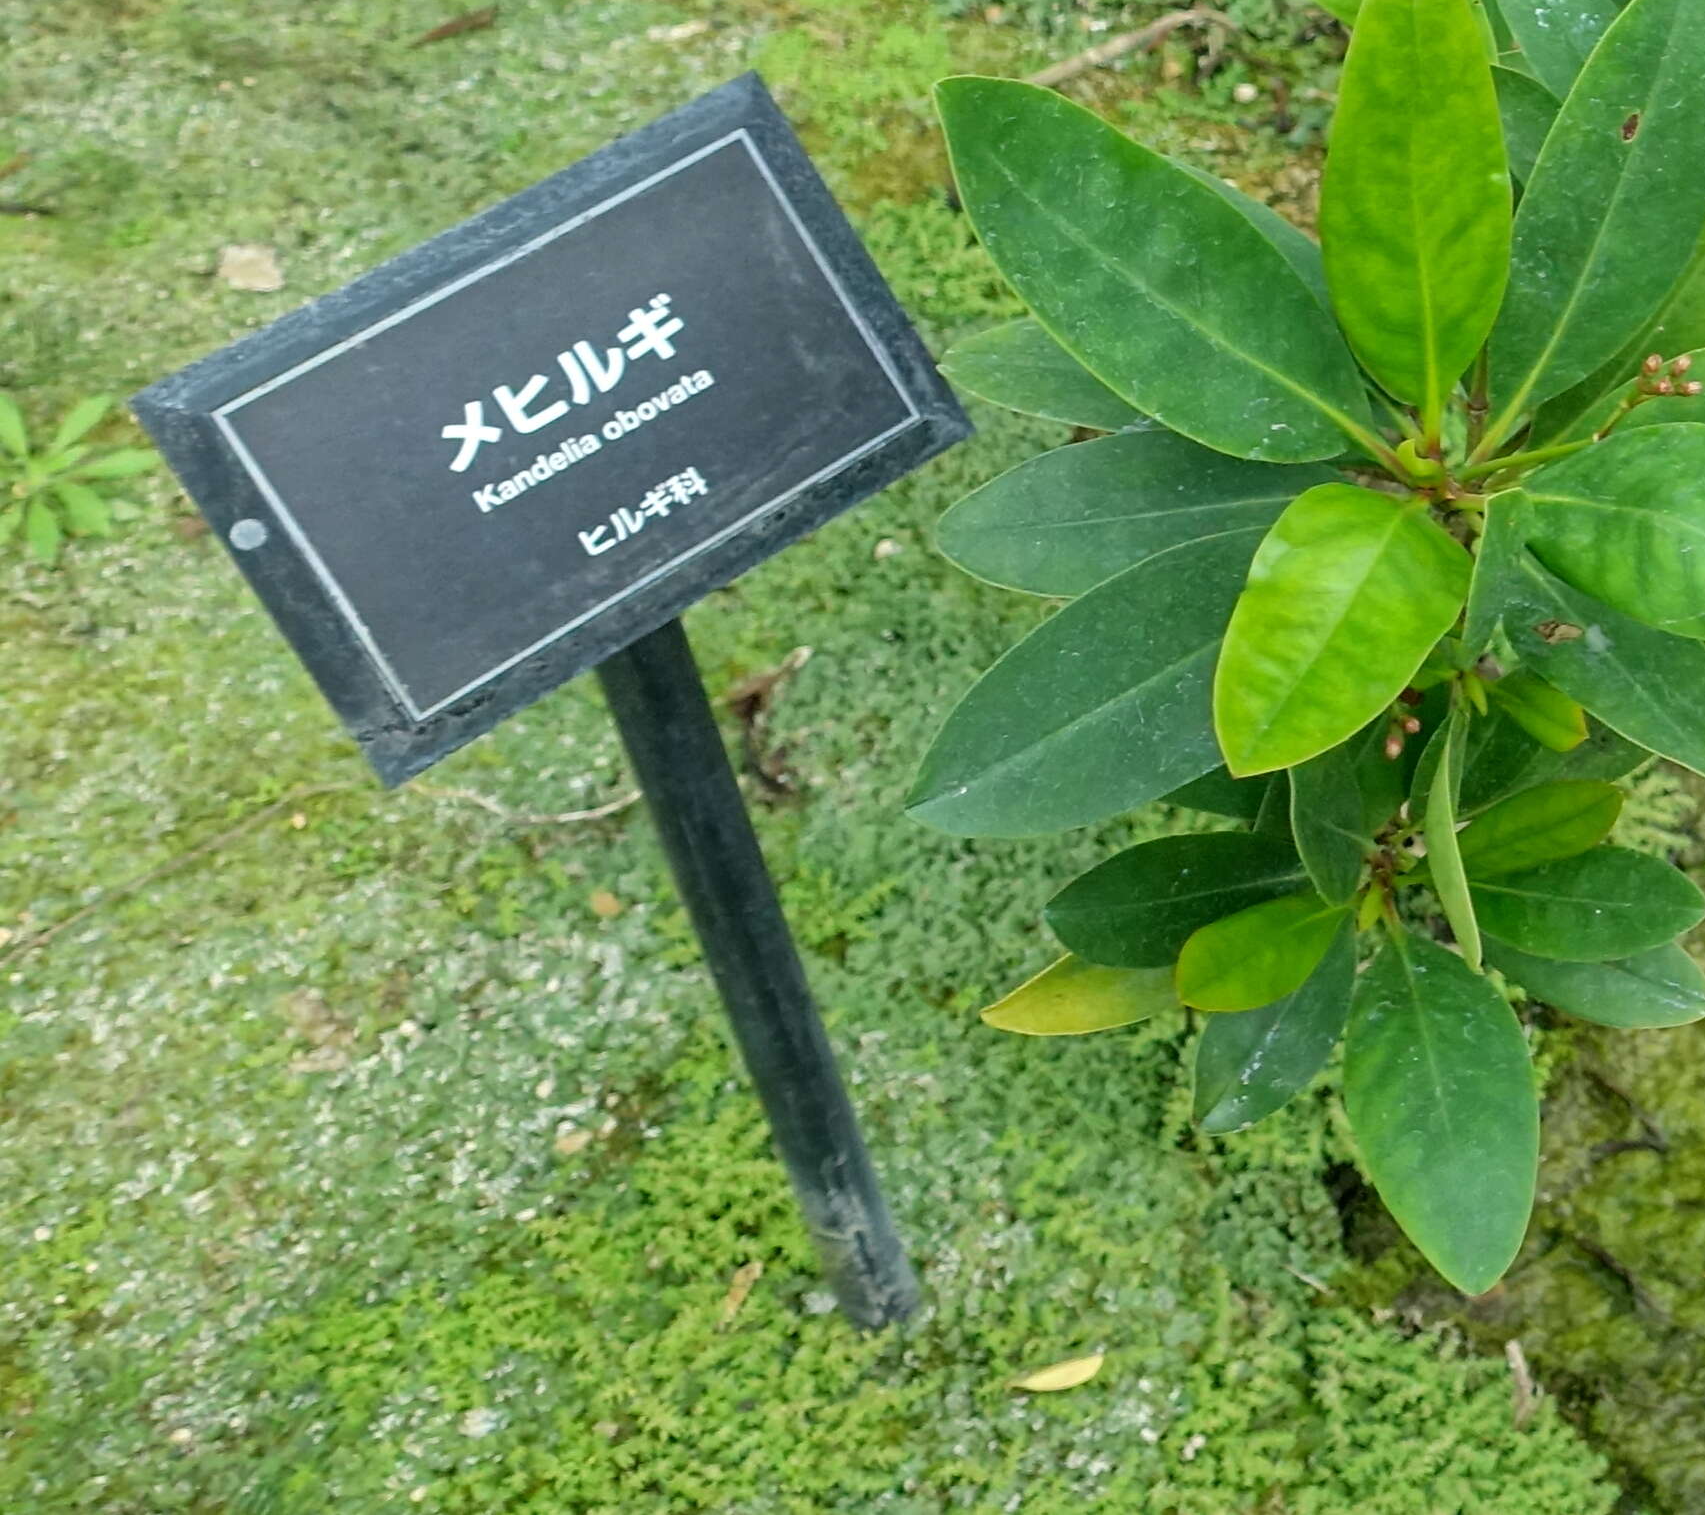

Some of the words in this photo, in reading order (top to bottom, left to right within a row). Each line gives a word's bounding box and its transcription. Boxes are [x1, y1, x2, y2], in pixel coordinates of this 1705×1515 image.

[441, 293, 684, 472] メヒルギ
[472, 433, 602, 513] Kandelia
[602, 369, 715, 441] obovata
[578, 466, 709, 556] ヒルギ科
